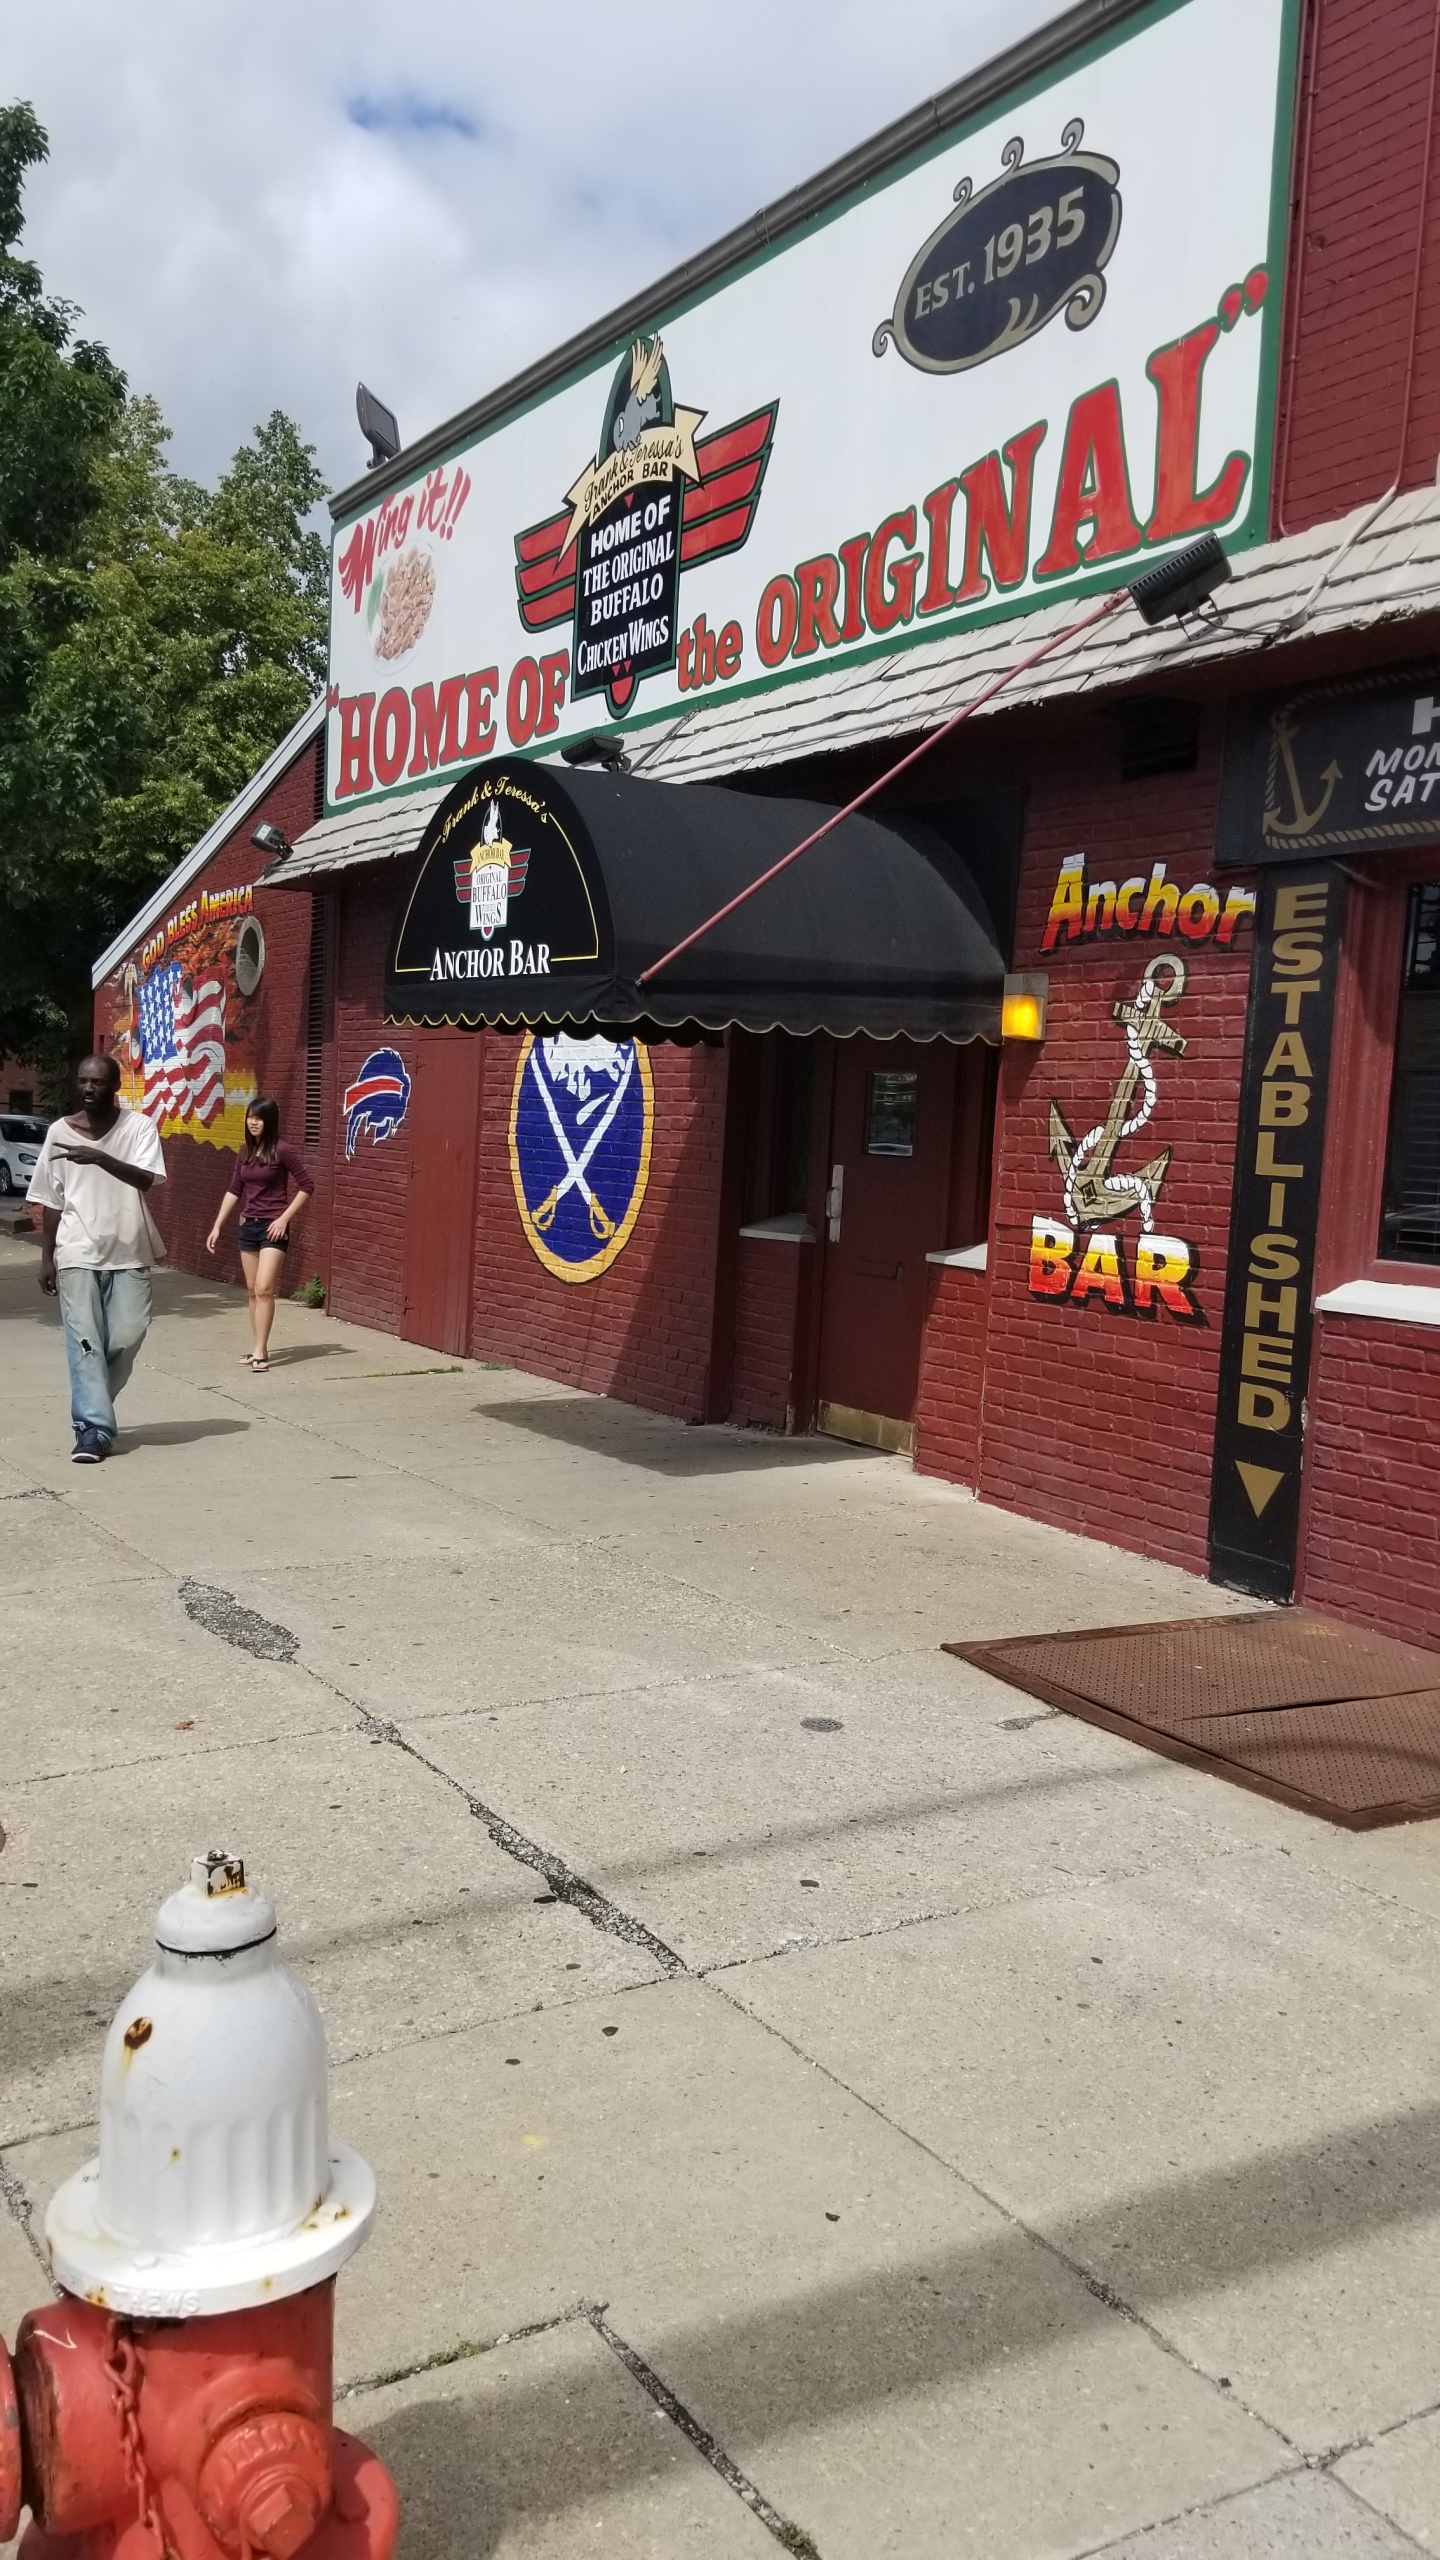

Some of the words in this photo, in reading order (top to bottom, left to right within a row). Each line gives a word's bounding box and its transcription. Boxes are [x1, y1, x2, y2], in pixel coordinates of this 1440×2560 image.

[915, 260, 975, 320] EST.
[982, 186, 1085, 286] 1935
[584, 457, 618, 512] Frank
[629, 435, 684, 466] Teressa's
[593, 469, 634, 519] ANCHOR
[642, 461, 668, 479] BAR
[338, 492, 414, 614] Wing
[417, 464, 471, 541] it!!
[591, 510, 641, 558] HOME
[644, 494, 671, 531] OF
[583, 559, 610, 597] THE
[612, 531, 674, 583] ORIGINAL
[590, 573, 664, 626] BUFFALO
[577, 631, 628, 676] CHICKEN
[628, 615, 669, 656] WINGS
[506, 648, 570, 748] OF
[676, 613, 743, 692] the
[442, 786, 479, 843] Frank
[481, 780, 492, 800] &
[495, 776, 547, 824] Teressa's
[473, 883, 506, 902] BUFFALO
[476, 871, 502, 885] ORIGINAL
[1038, 852, 1257, 956] Anchor
[142, 931, 165, 973] GOD
[167, 900, 198, 946] BLESS
[200, 884, 254, 924] AMERICA
[475, 902, 502, 925] WINGS
[430, 947, 504, 981] ANCHOR
[509, 940, 551, 976] BAR
[1238, 882, 1329, 1431] ESTABLISHED
[1028, 1215, 1203, 1322] BAR
